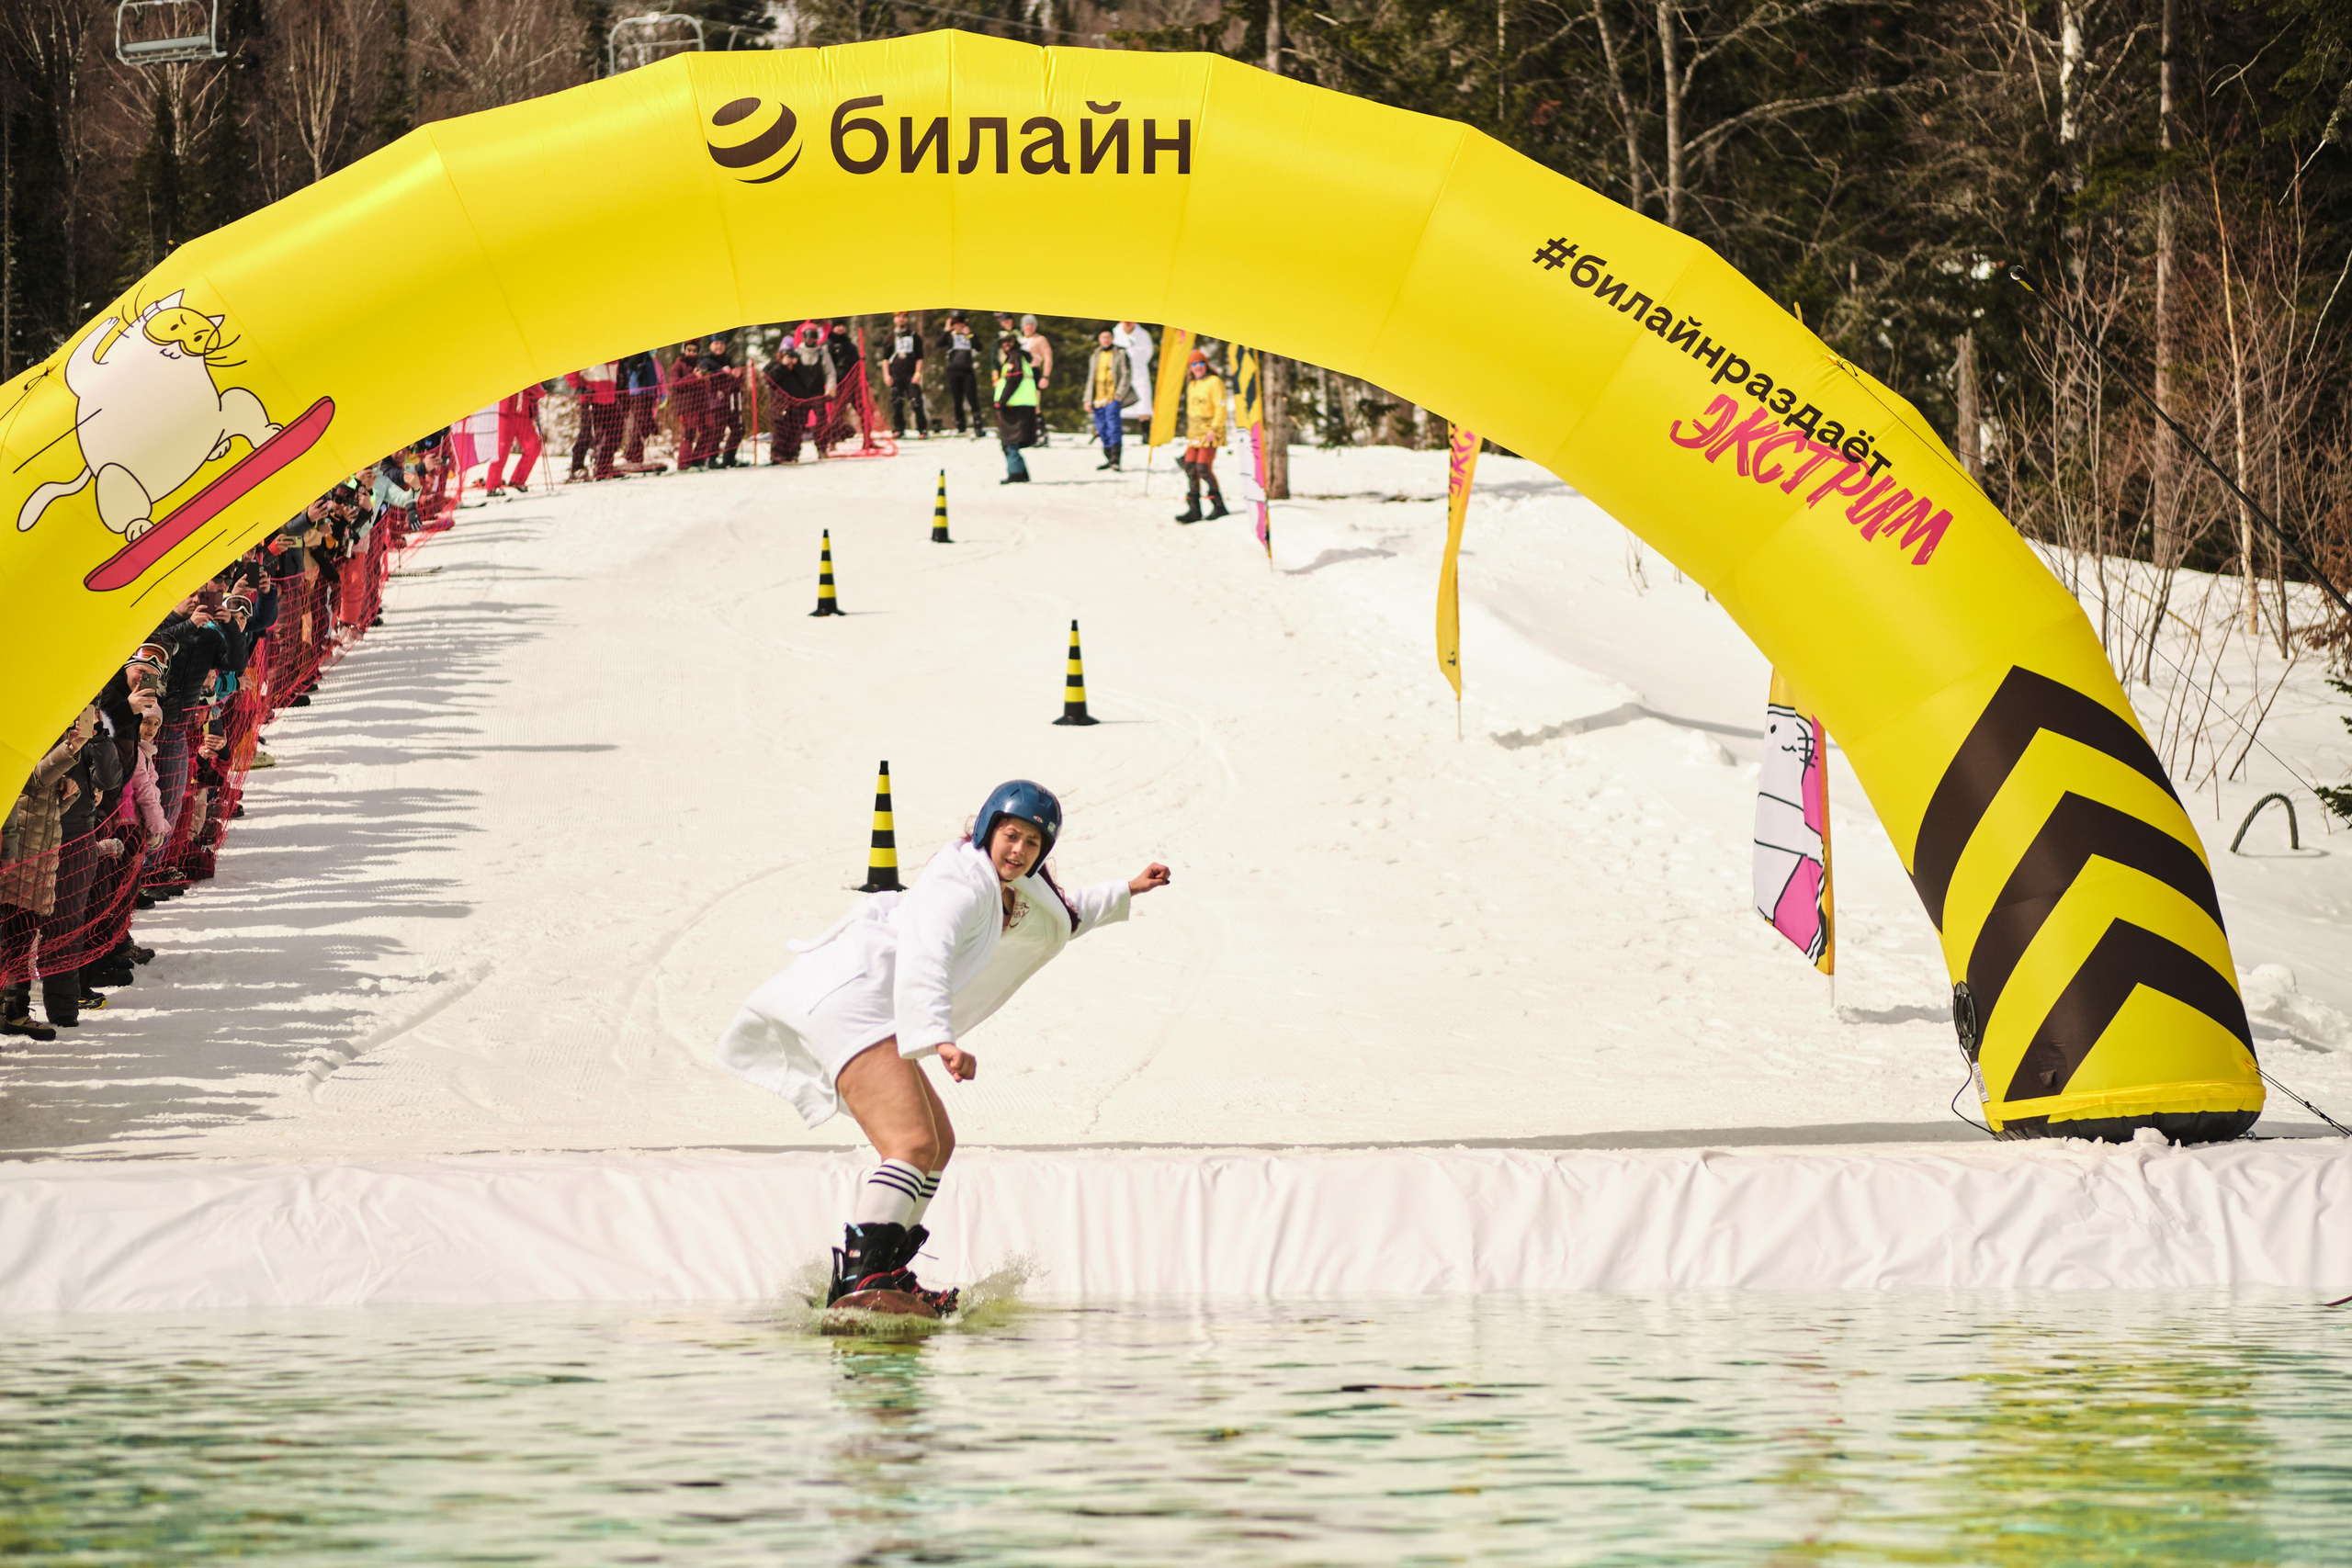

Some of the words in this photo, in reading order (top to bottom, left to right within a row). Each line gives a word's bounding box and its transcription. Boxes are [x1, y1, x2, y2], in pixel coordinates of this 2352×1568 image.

[831, 95, 1191, 175] билайн
[1532, 237, 1892, 477] #билайнраздаёт
[1669, 393, 1953, 566] ЭКСТРИМ
